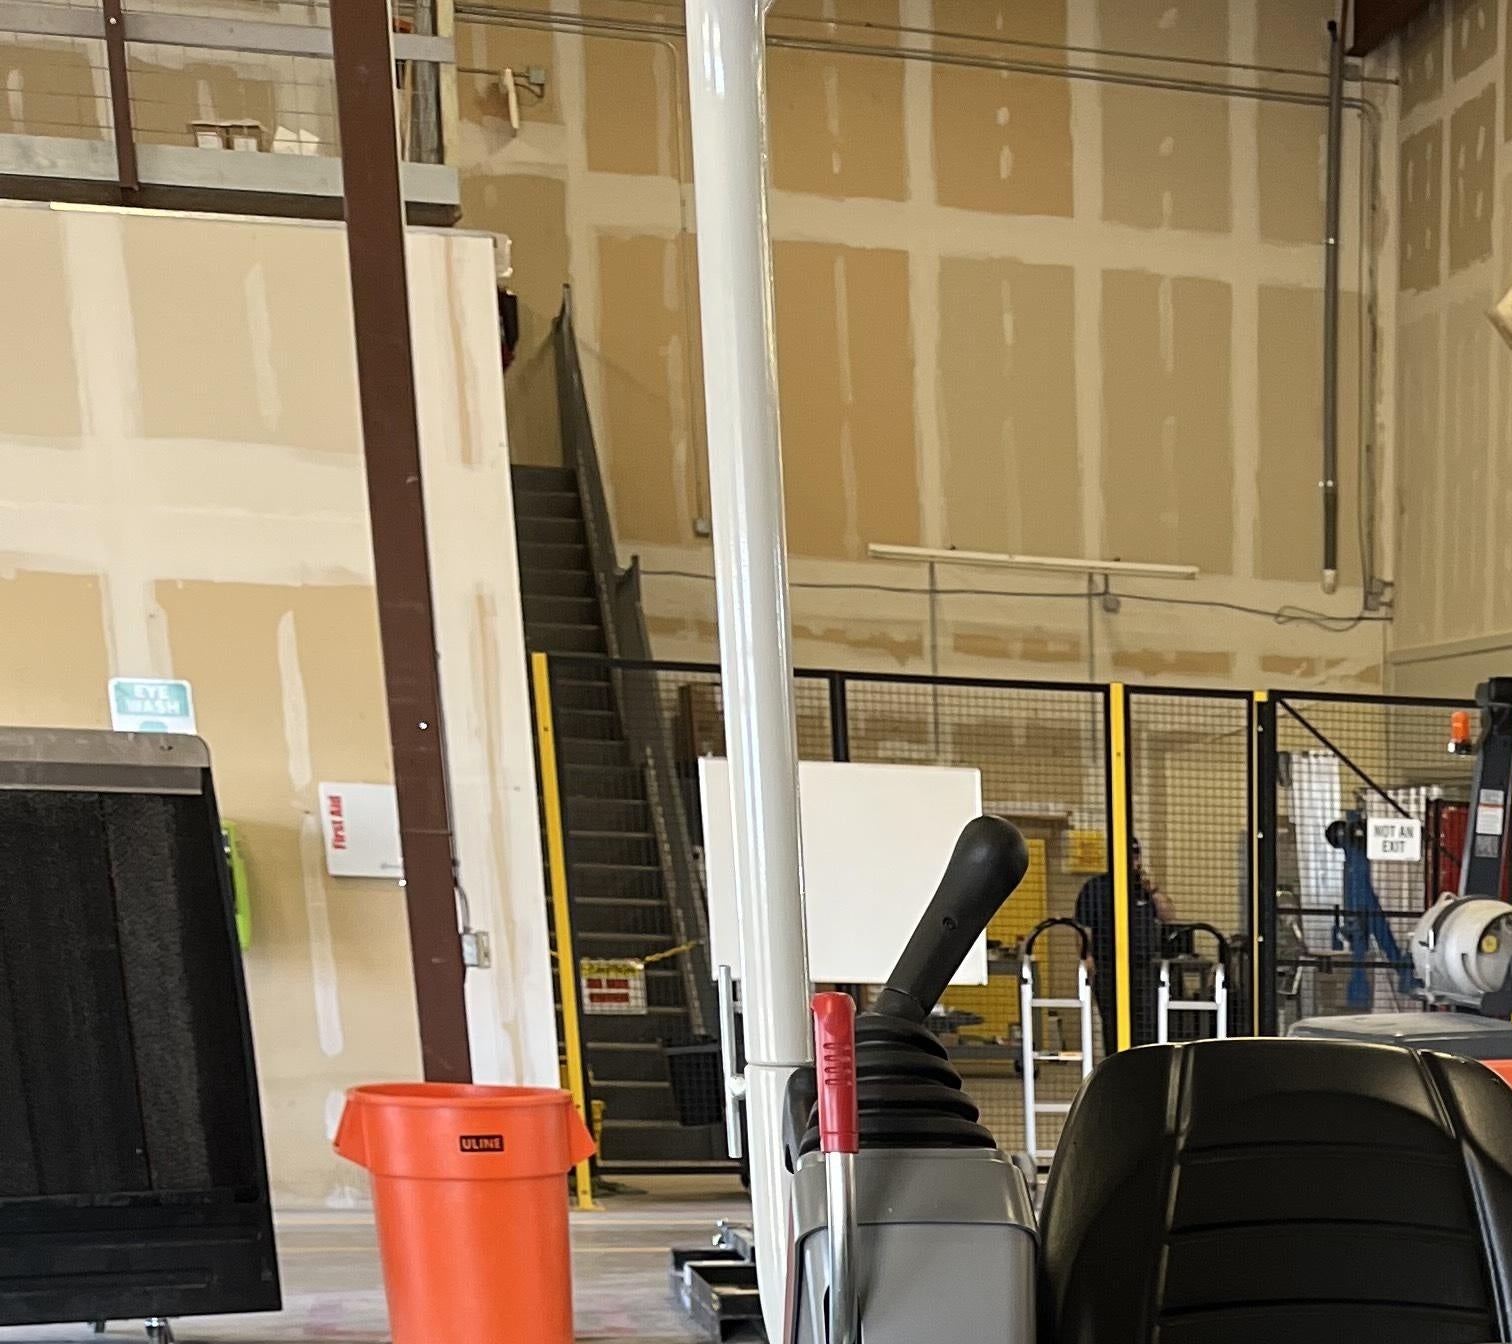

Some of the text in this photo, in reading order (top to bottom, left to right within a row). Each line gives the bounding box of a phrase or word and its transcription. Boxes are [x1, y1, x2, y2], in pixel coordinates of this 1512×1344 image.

[134, 685, 168, 698] EYE
[127, 699, 180, 714] WASH
[328, 796, 347, 850] First Aid
[1374, 825, 1414, 839] NOT AN
[1382, 841, 1405, 853] EXIT
[462, 1138, 501, 1149] ULINE
